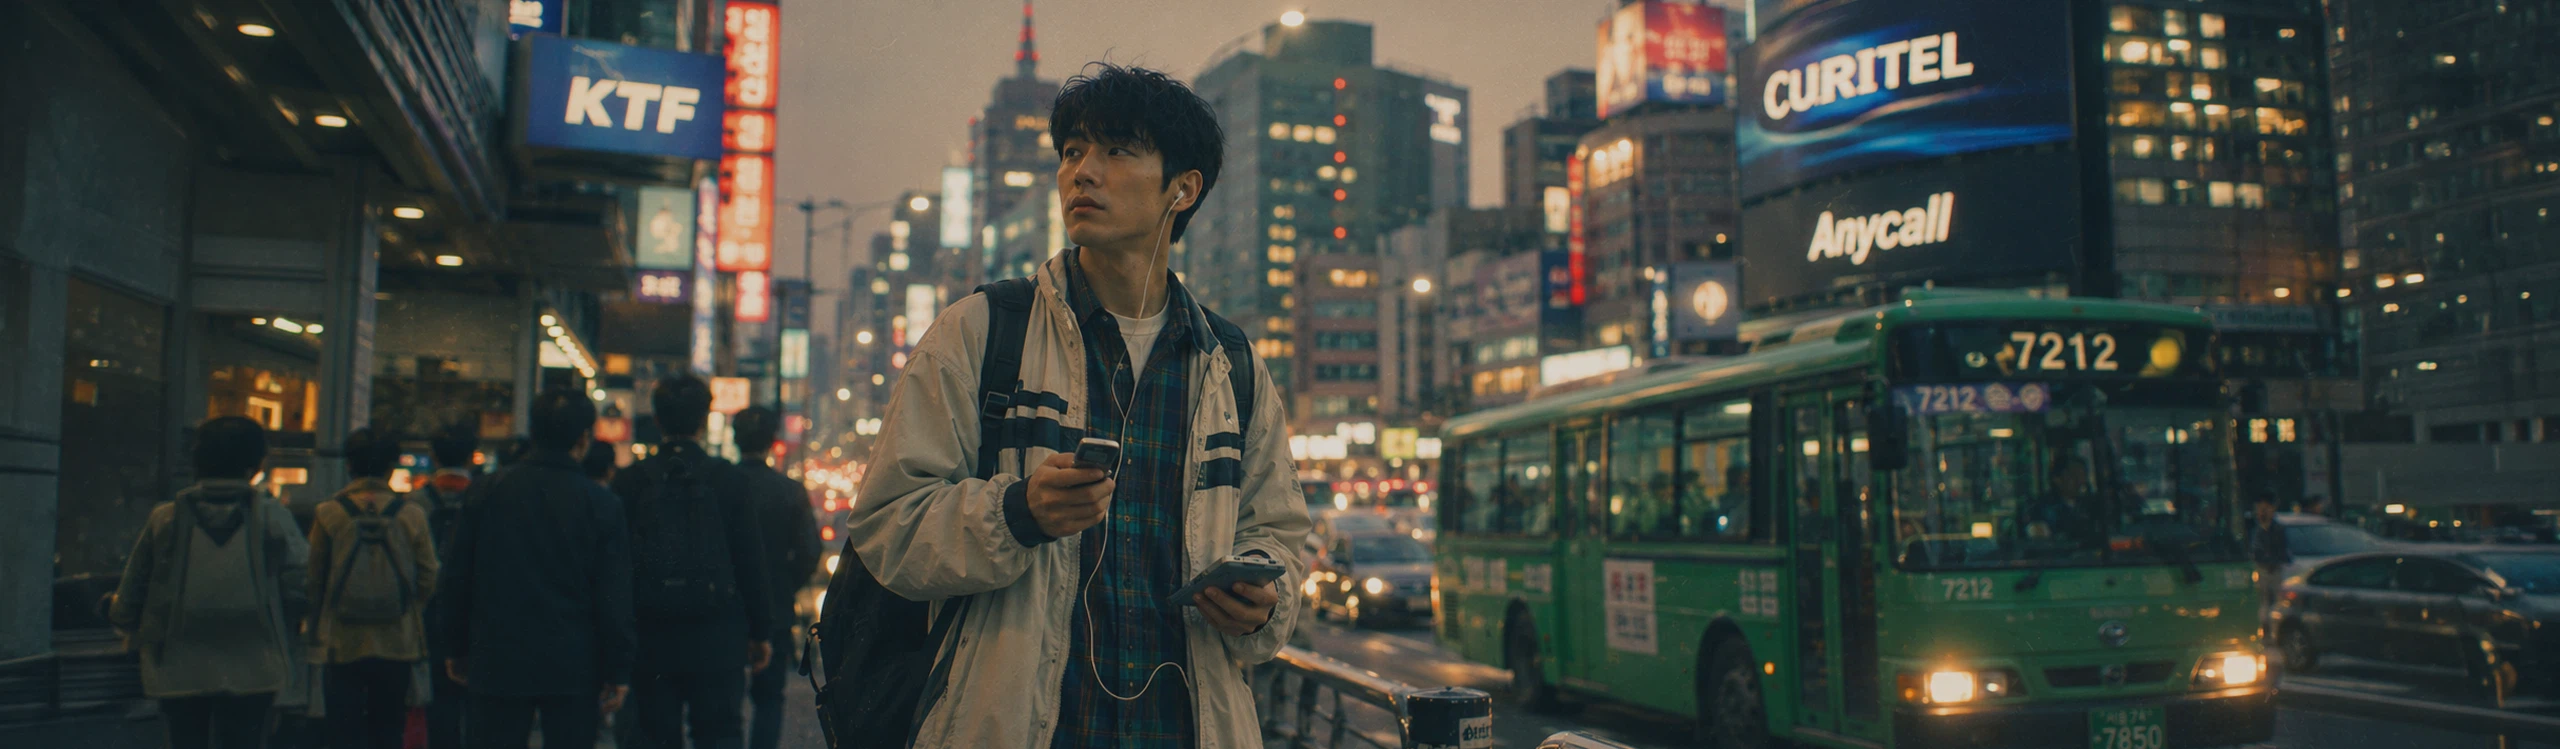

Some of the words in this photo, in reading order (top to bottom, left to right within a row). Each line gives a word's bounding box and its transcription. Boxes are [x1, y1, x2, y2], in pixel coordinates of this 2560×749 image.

[1763, 31, 1975, 121] CURITEL
[564, 76, 701, 135] KTF
[1806, 190, 1956, 266] Anycall
[2010, 331, 2119, 371] 7212
[1915, 384, 1976, 412] 7212
[1941, 578, 1993, 601] 7212
[2102, 724, 2162, 749] 7850
